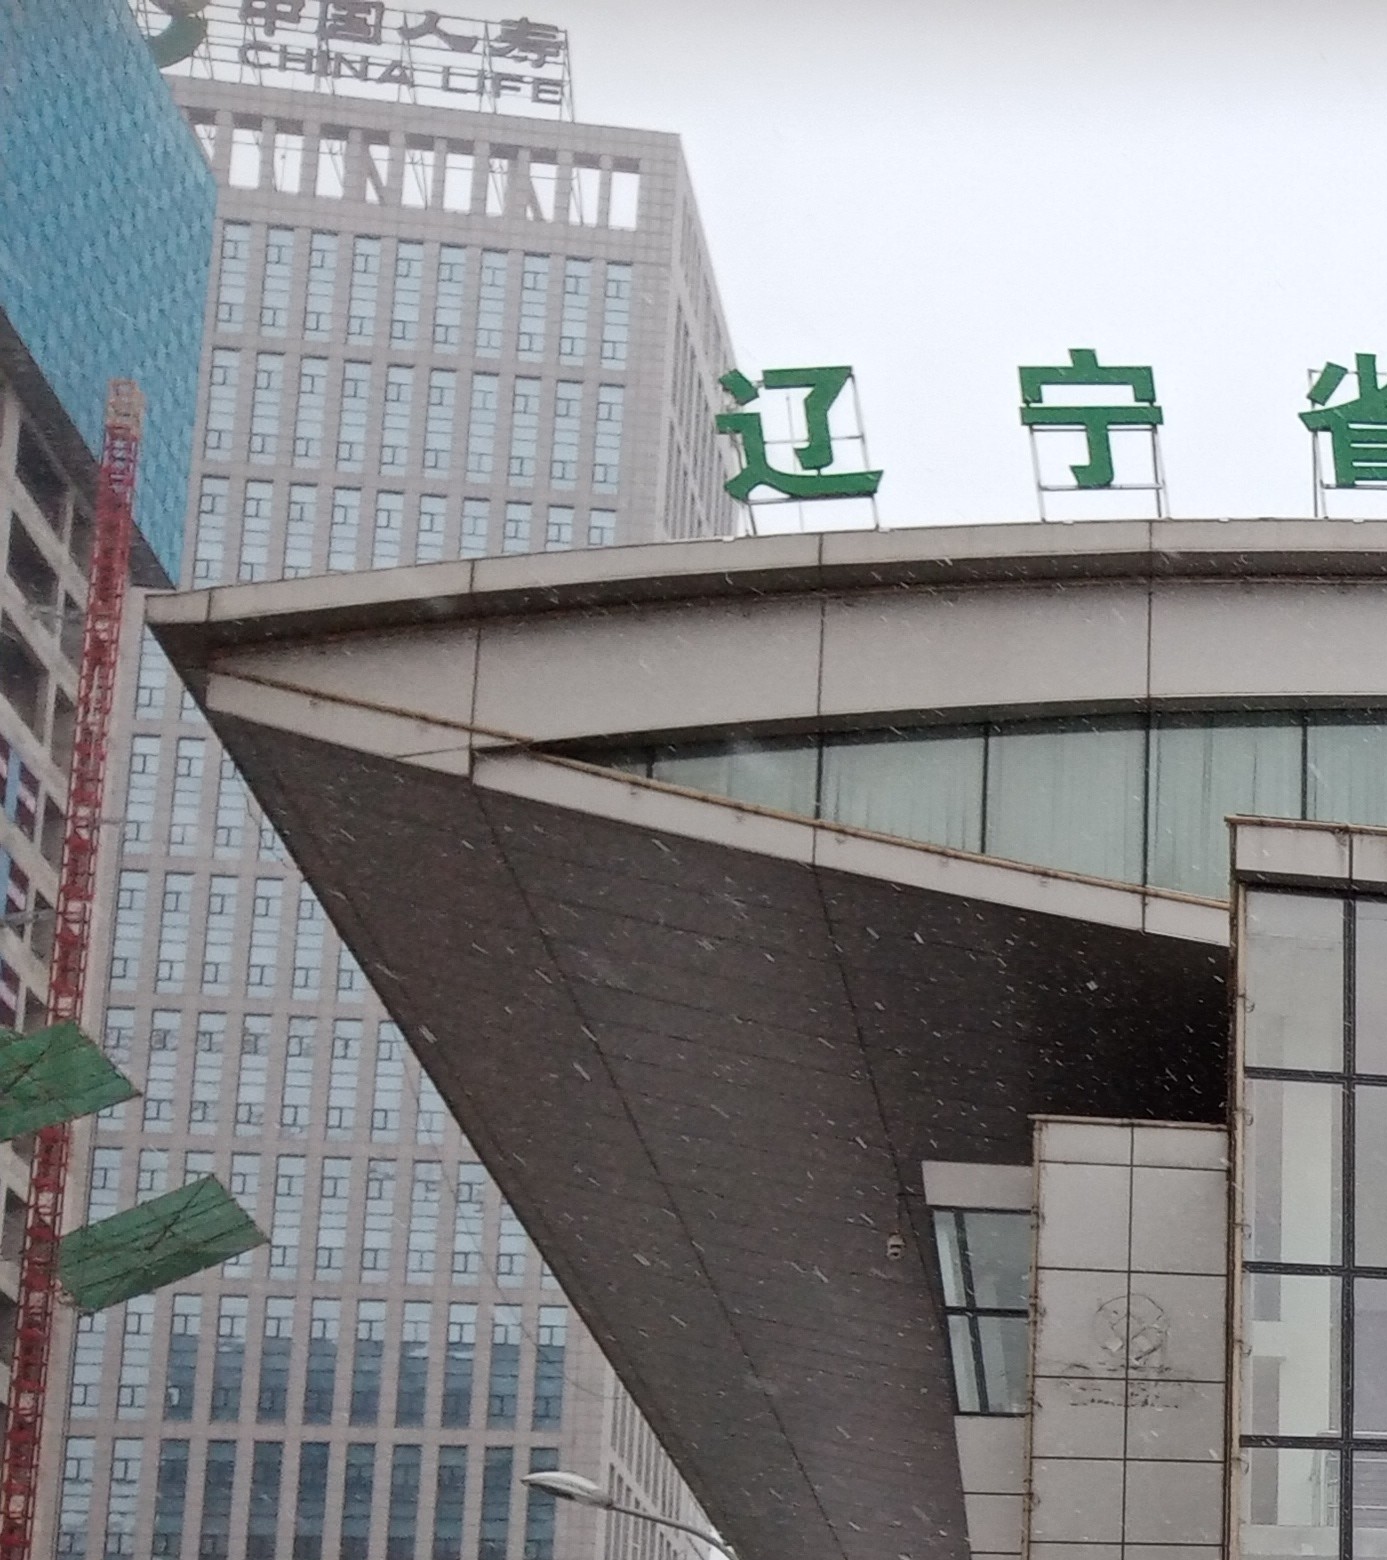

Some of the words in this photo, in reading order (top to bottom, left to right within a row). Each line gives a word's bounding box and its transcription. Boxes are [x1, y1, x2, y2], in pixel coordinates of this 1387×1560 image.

[238, 0, 566, 68] 中国人寿
[237, 41, 415, 87] CHINA
[441, 65, 564, 106] LIFE
